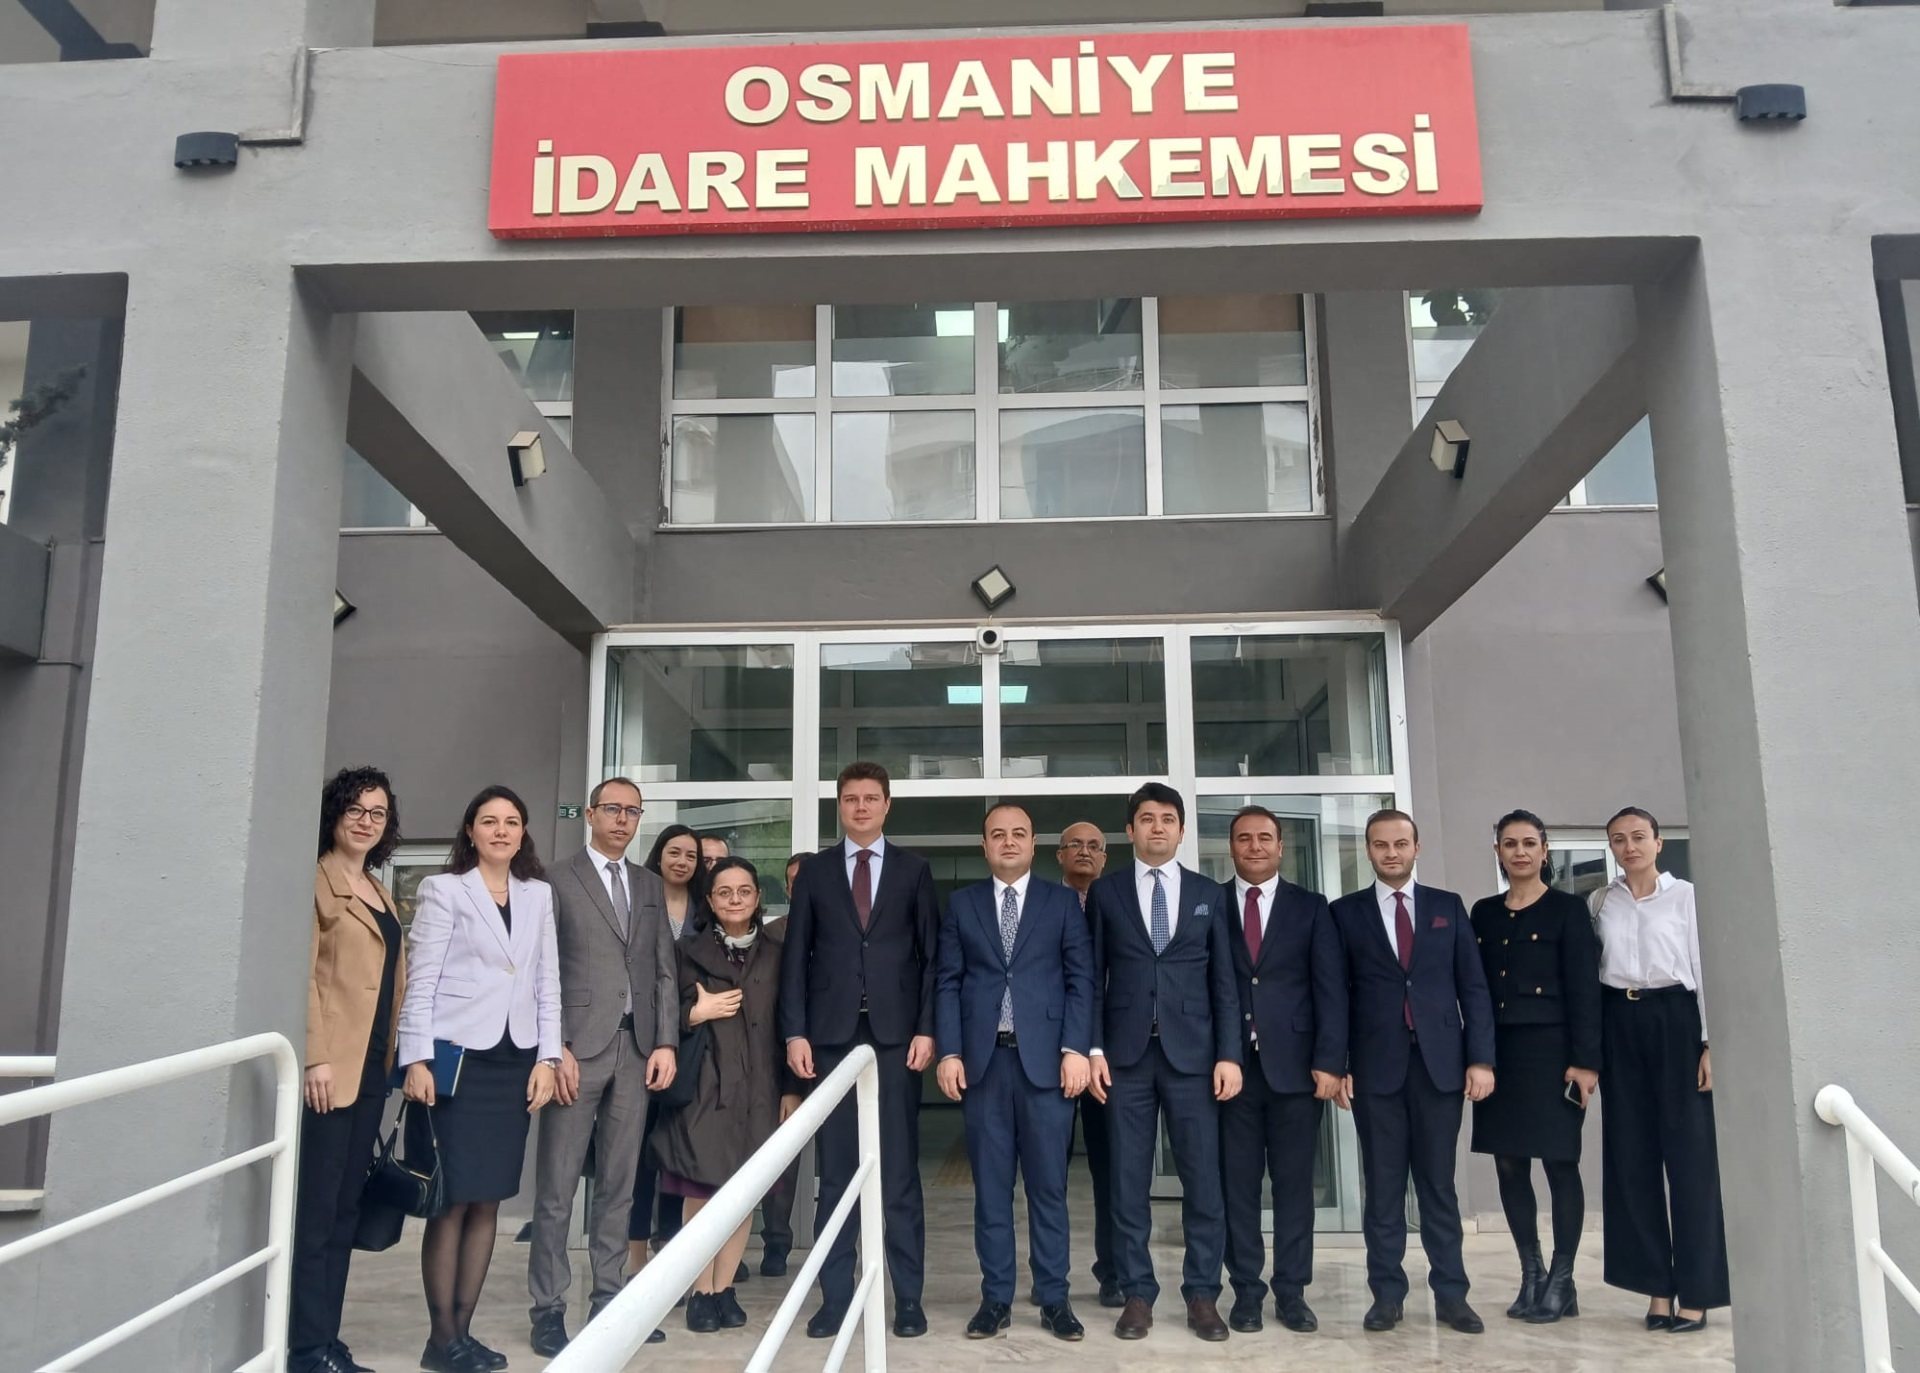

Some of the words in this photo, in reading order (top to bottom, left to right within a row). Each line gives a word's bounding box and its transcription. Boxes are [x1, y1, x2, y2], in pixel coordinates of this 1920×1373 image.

[724, 40, 1239, 125] OSMANİYE
[532, 139, 810, 215] İDARE
[854, 113, 1439, 207] MAHKEMESİ
[568, 808, 578, 819] 5
